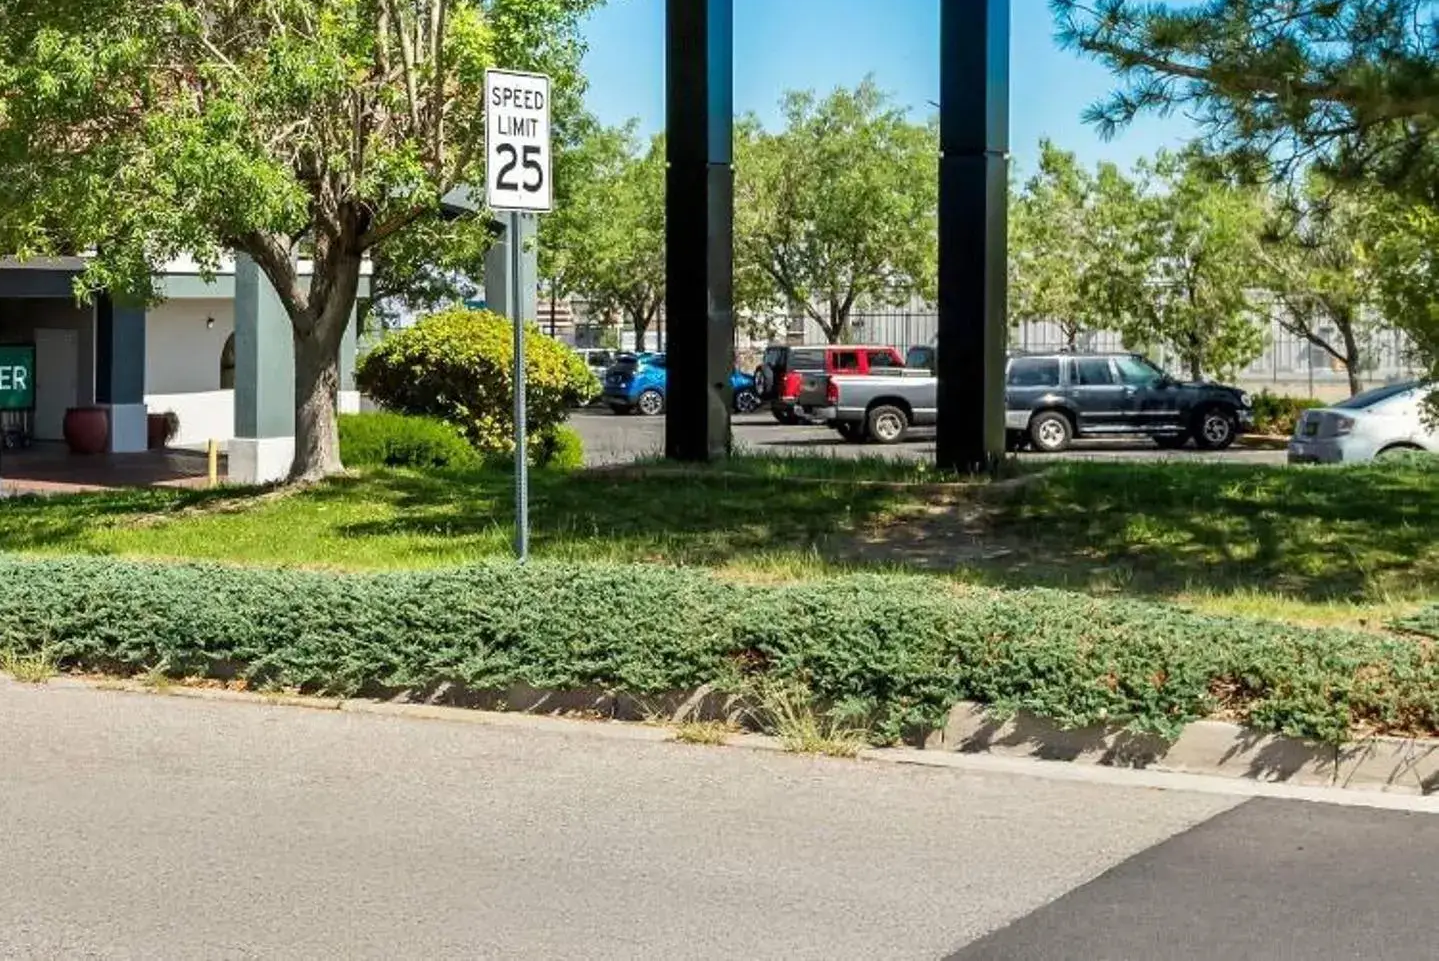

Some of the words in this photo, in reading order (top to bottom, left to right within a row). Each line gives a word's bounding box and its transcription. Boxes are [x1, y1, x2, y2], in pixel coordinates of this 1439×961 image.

[492, 86, 544, 110] SPEED
[498, 115, 538, 137] LIMIT
[496, 143, 543, 192] 25
